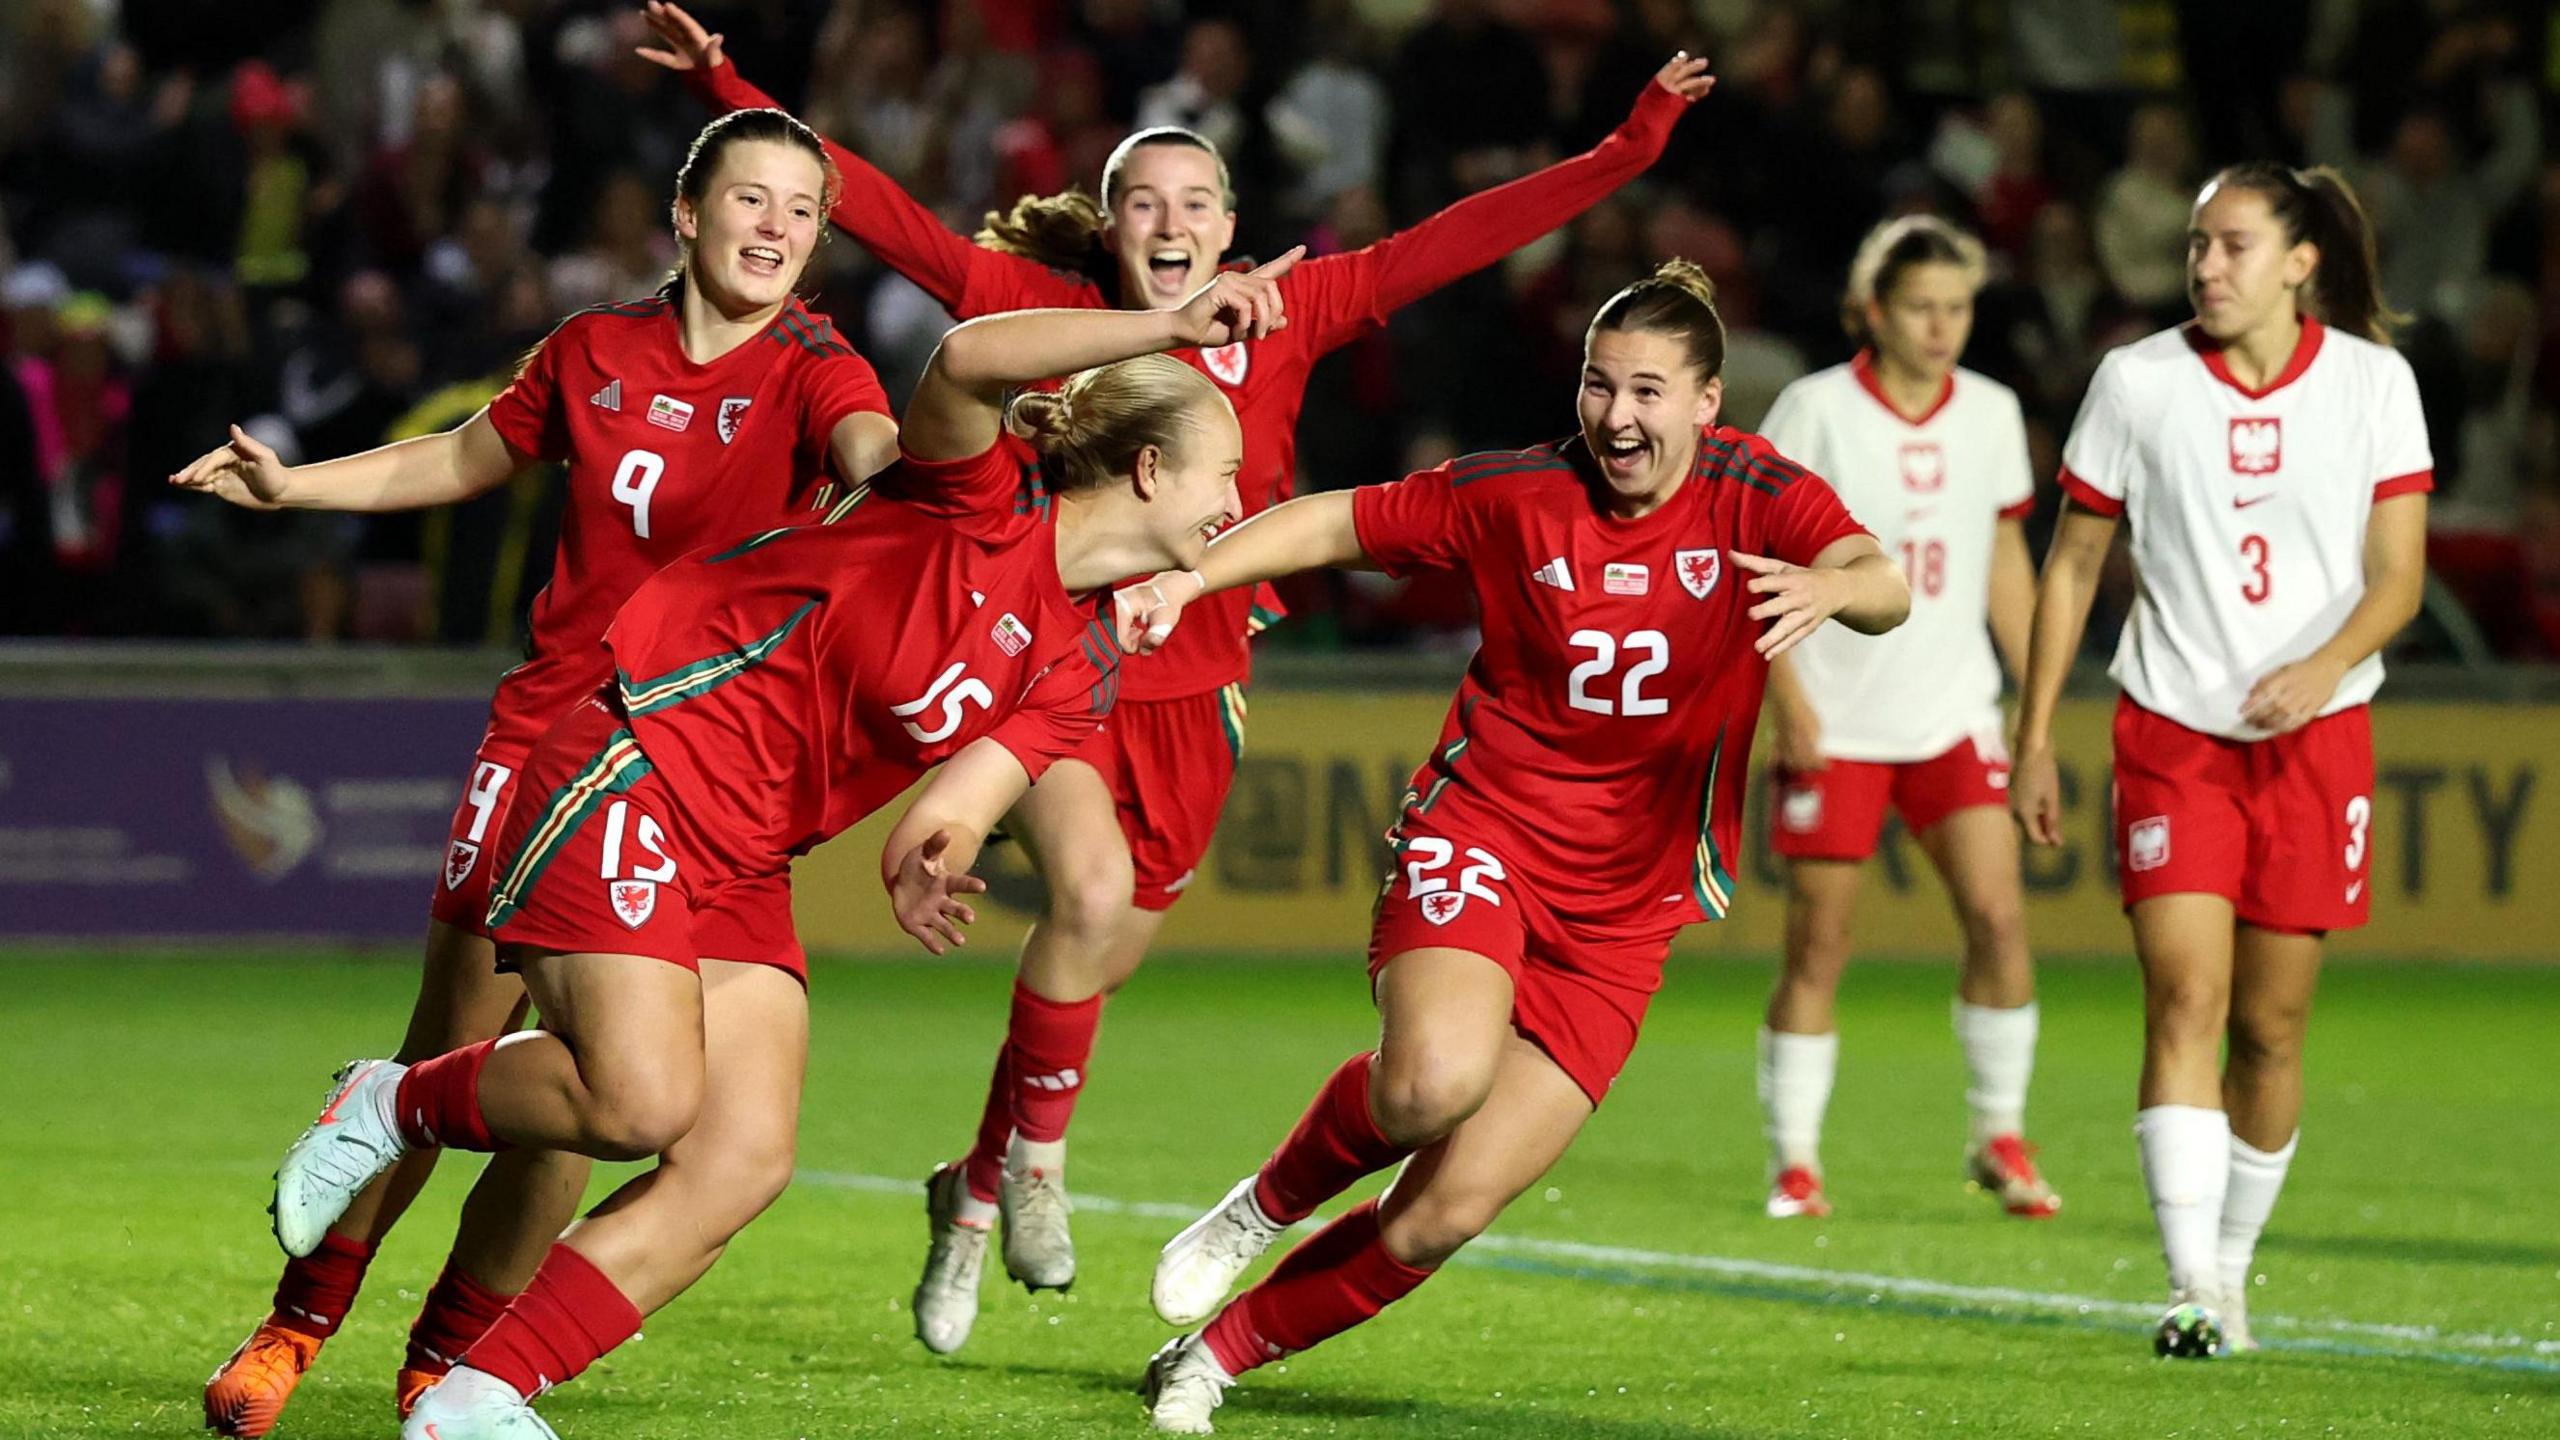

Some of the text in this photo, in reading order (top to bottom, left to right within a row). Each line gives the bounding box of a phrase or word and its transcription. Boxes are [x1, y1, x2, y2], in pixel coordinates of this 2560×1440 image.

[611, 449, 665, 539] 9
[1899, 538, 1948, 599] 18
[2239, 534, 2272, 604] 3
[889, 661, 994, 744] 15
[1568, 629, 1670, 716] 22
[468, 761, 512, 843] 9
[600, 800, 677, 883] 15
[2344, 796, 2370, 870] 3
[1407, 836, 1507, 907] 22
